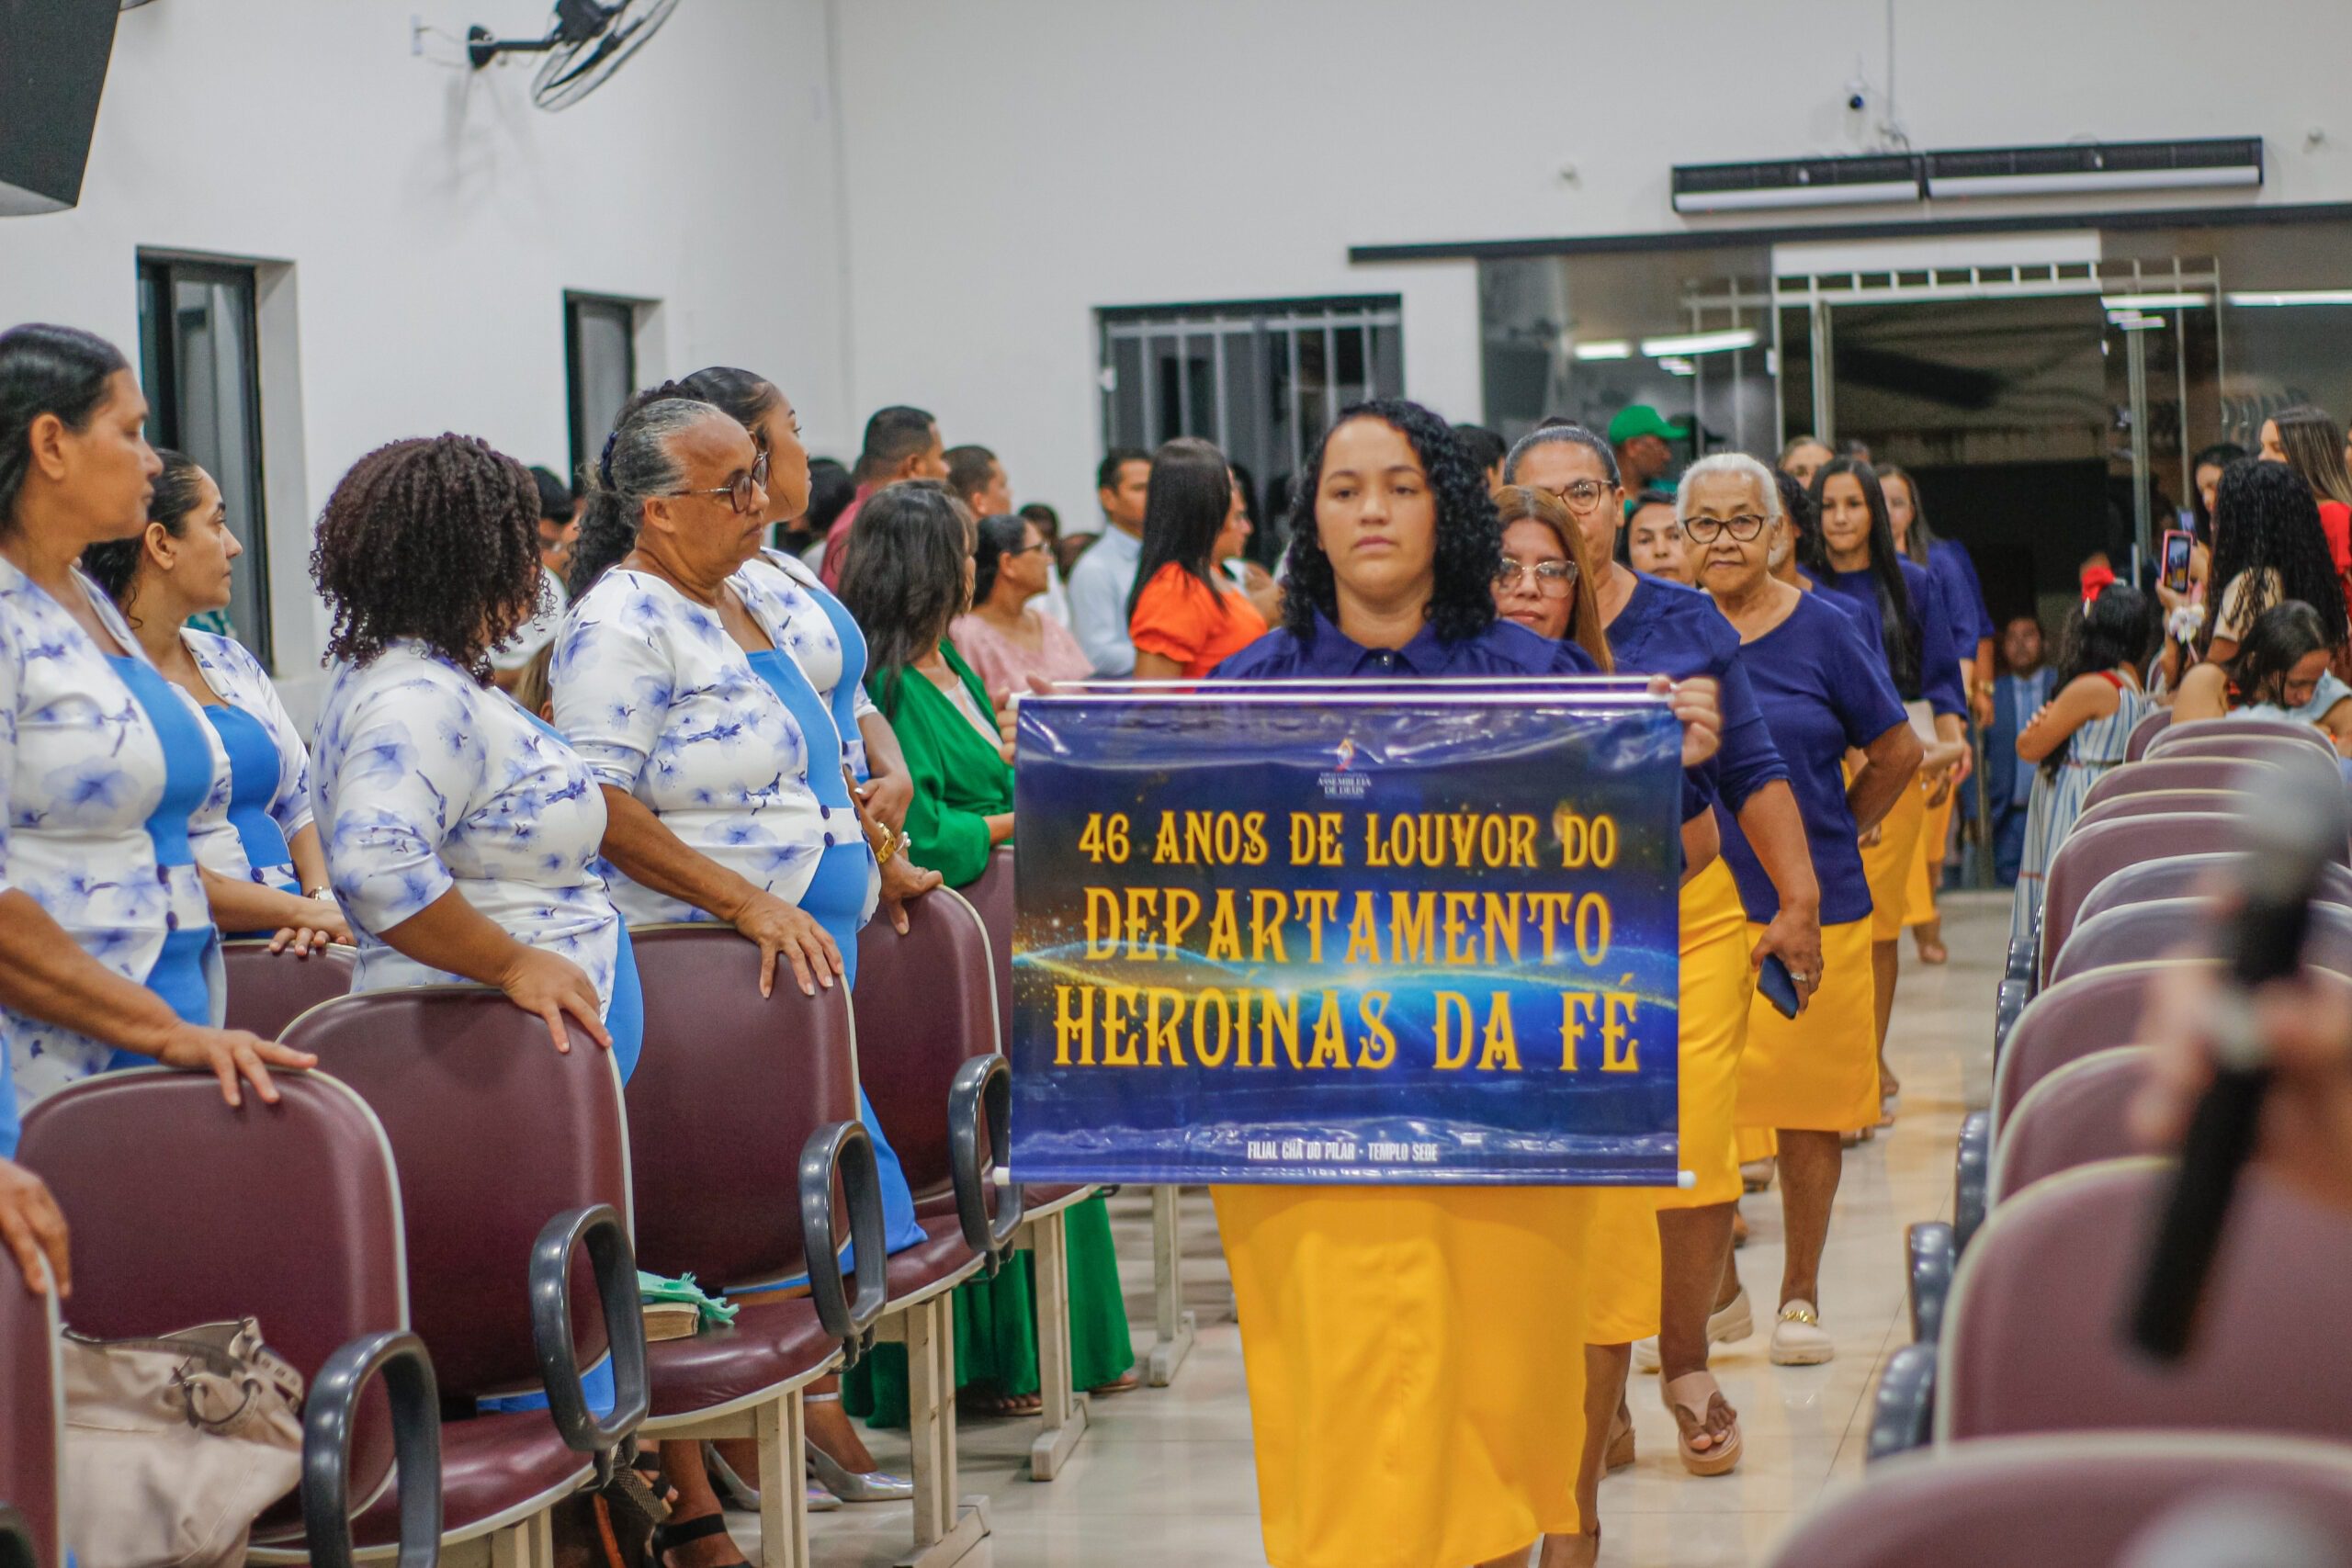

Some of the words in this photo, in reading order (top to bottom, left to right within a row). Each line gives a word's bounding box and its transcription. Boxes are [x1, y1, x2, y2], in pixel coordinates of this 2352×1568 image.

[1079, 812, 1129, 863] 46
[1152, 810, 1269, 865] ANOS
[1289, 812, 1344, 865] DE
[1365, 813, 1539, 868] LOUVOR
[1562, 814, 1617, 868] DO
[1083, 886, 1611, 966] DEPARTAMENTO
[1053, 968, 1396, 1070] HEROÍNAS
[1430, 990, 1522, 1070] DA
[1558, 972, 1639, 1072] FÉ
[1248, 1141, 1278, 1160] FILIAL
[1307, 1141, 1322, 1160] DO
[1325, 1142, 1355, 1160] PILAR
[1368, 1143, 1408, 1161] TEMPLO
[1412, 1143, 1438, 1162] SEDE
